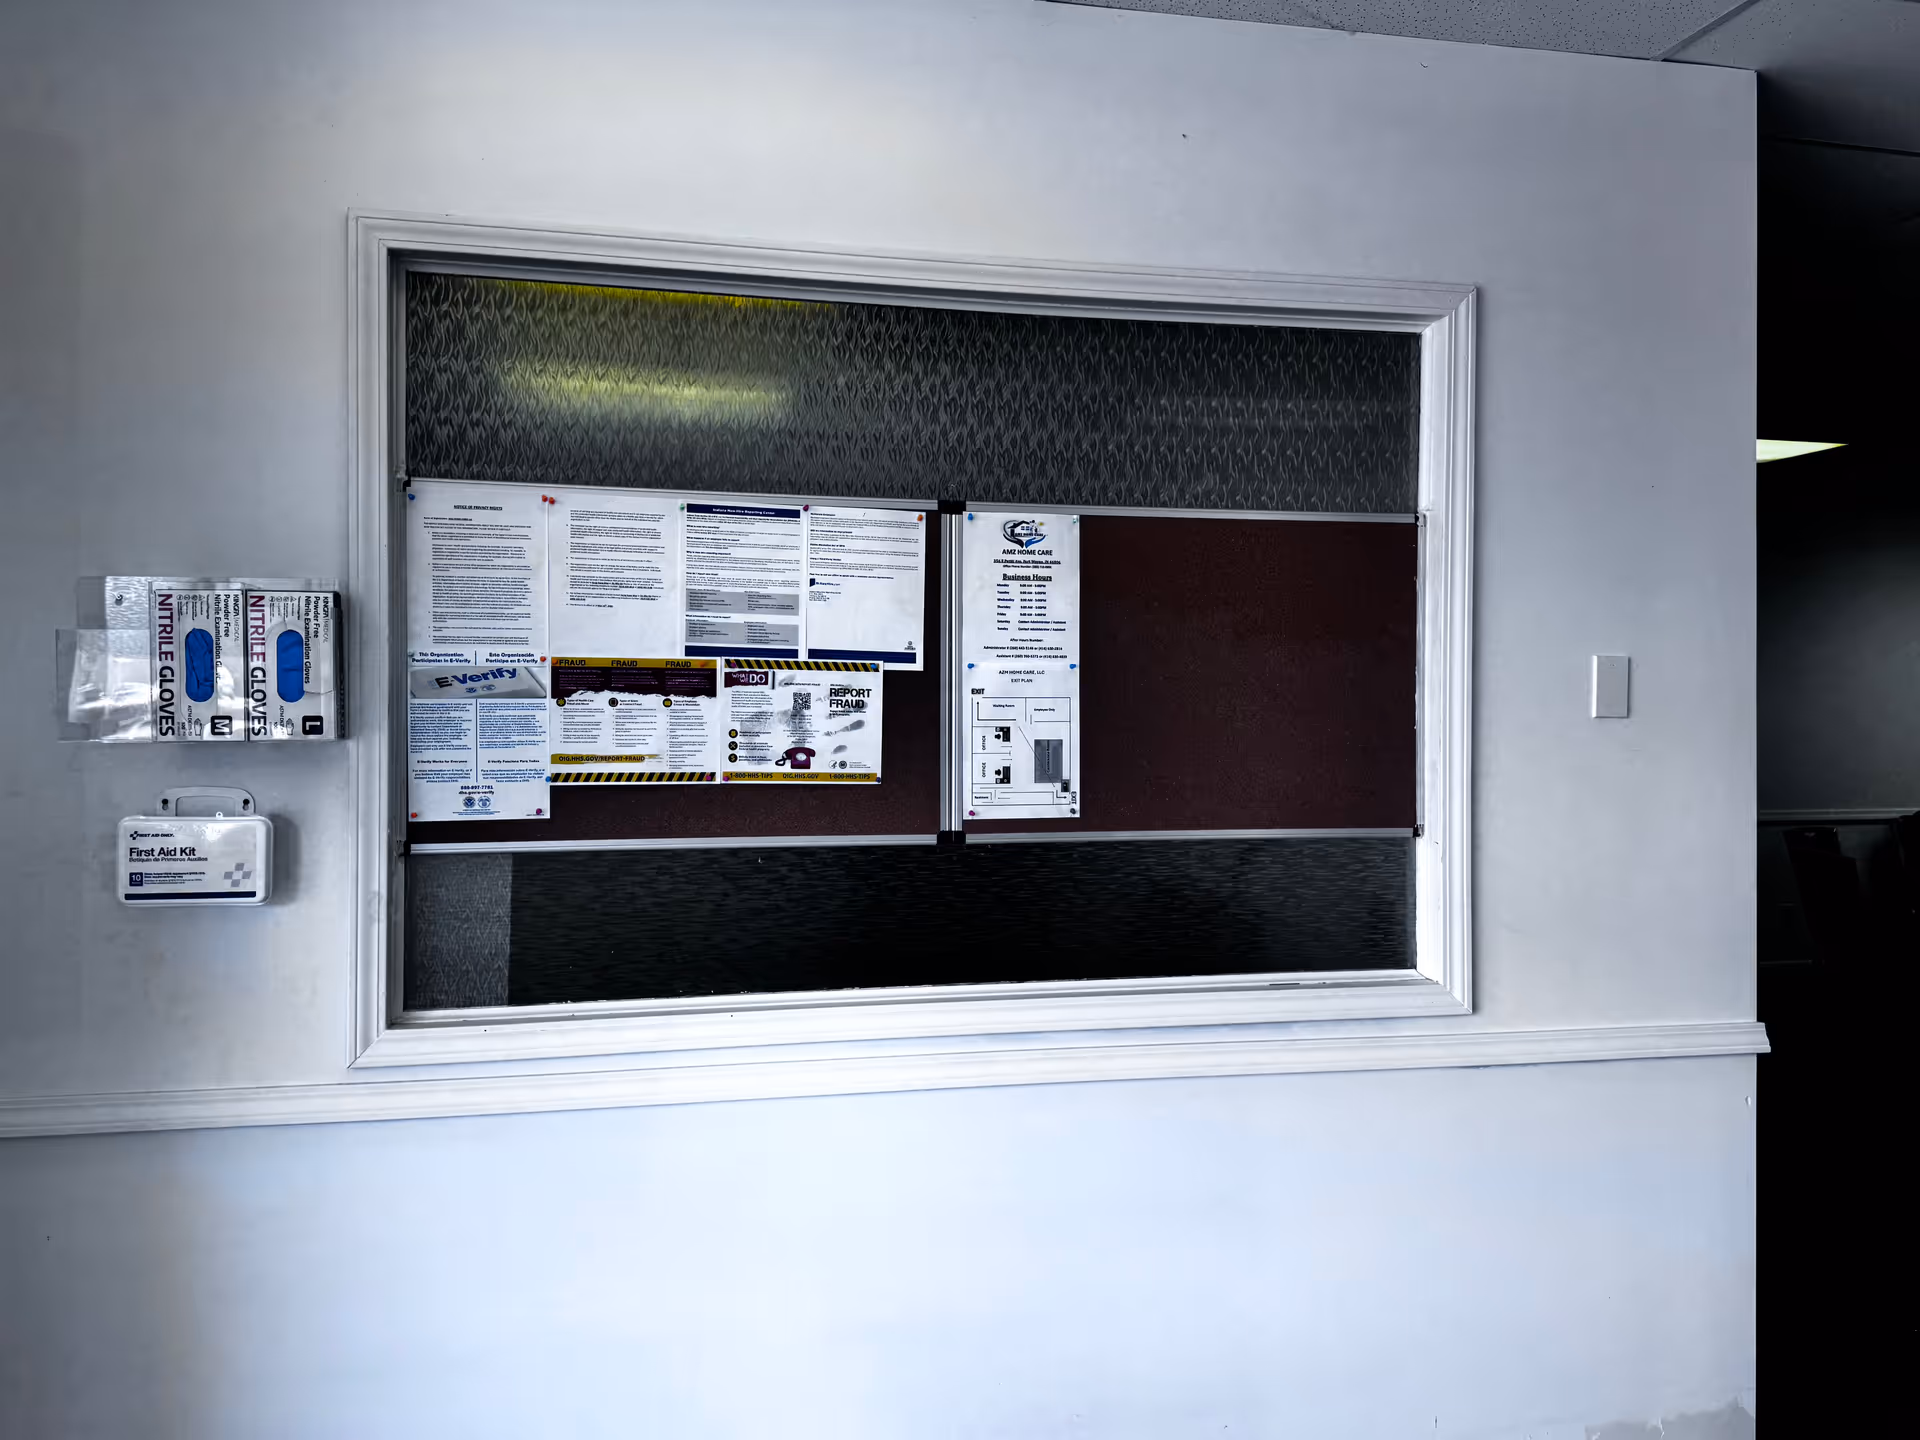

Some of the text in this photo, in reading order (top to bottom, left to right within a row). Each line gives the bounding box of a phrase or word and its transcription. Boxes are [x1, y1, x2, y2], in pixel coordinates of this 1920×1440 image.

[158, 594, 176, 736] NITRILE GLOVES
[250, 595, 268, 736] NITRILE GLOVES
[434, 668, 518, 688] E-Verify
[750, 674, 766, 684] DO
[830, 688, 872, 698] REPORT
[830, 699, 864, 709] FRAUD
[214, 720, 229, 732] M
[306, 722, 320, 730] L
[130, 846, 196, 857] First Aid Kit
[132, 874, 142, 882] 10
